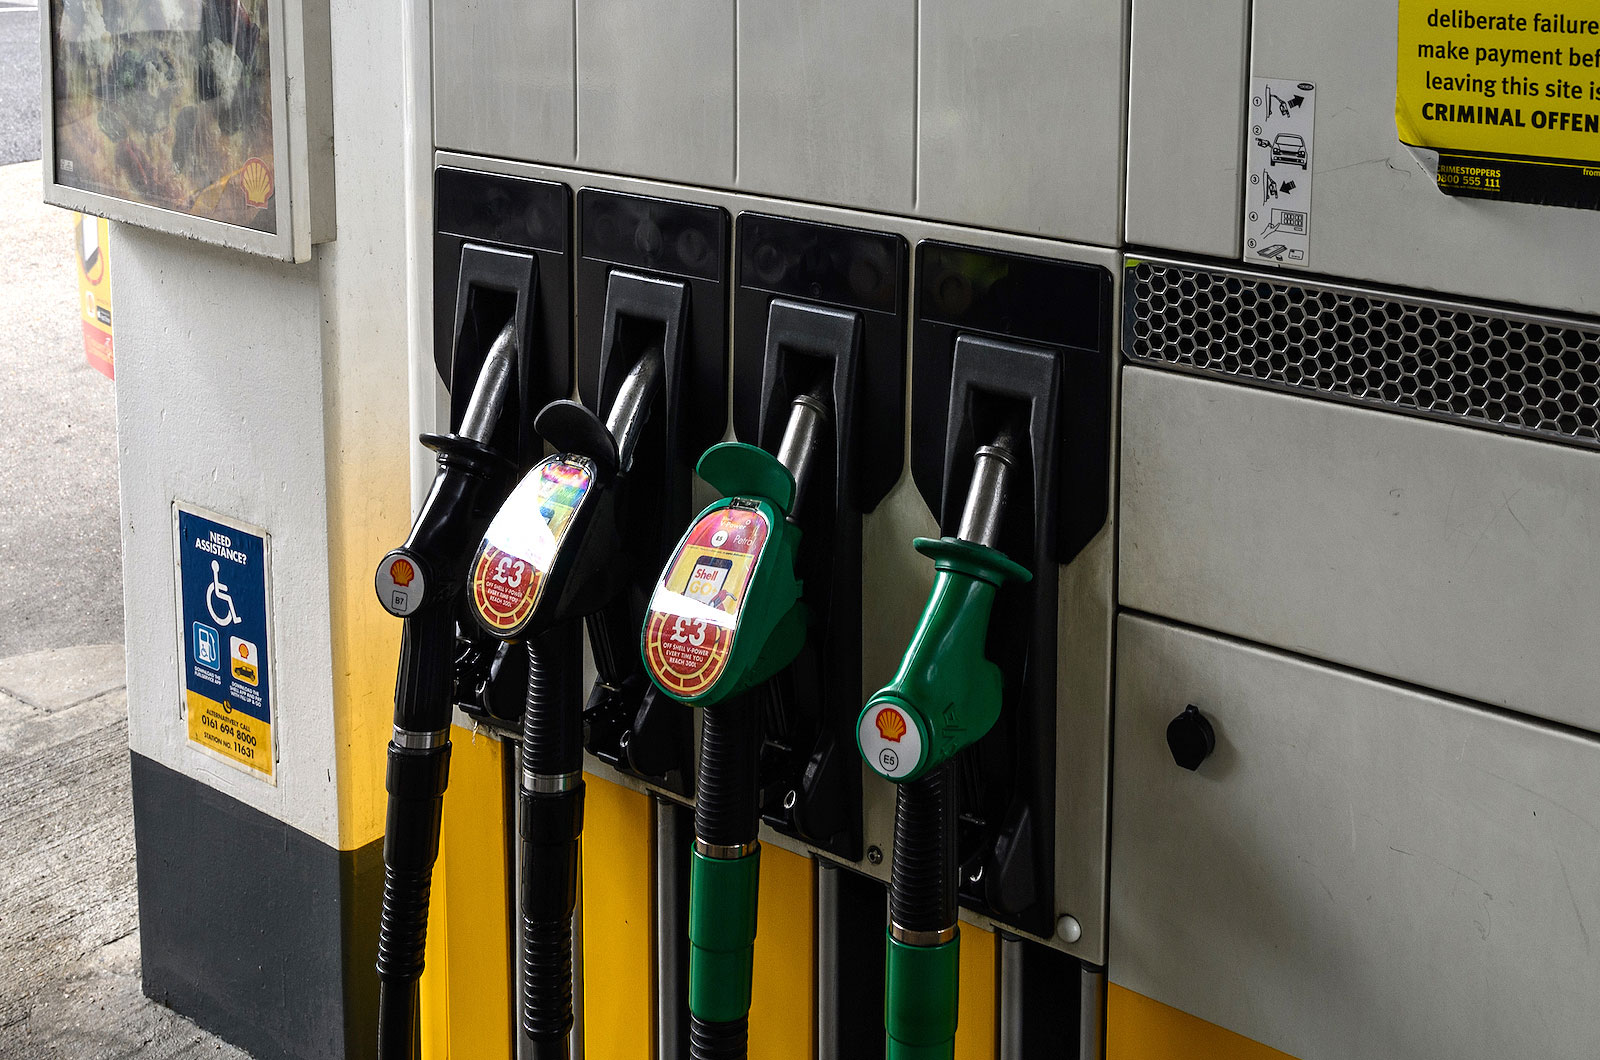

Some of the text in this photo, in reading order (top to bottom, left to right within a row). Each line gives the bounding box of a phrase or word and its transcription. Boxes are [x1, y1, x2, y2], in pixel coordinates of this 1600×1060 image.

[1427, 8, 1600, 35] deliberate failure
[1418, 40, 1470, 60] make
[1475, 47, 1563, 67] payment
[1426, 70, 1497, 98] leaving
[1501, 76, 1539, 97] this
[1545, 79, 1583, 99] site
[1421, 102, 1600, 133] CRIMINAL OFFEN
[1583, 167, 1600, 177] from
[1462, 176, 1481, 186] 555
[1485, 178, 1500, 188] 111
[209, 530, 232, 548] NEED
[195, 537, 247, 565] ASSISTANCE?
[492, 556, 526, 588] £3
[694, 568, 719, 582] Shell
[487, 588, 519, 603] EVERY TIME YOU
[494, 584, 505, 592] SHELL
[504, 587, 523, 598] V-POWER
[395, 596, 405, 605] B7
[490, 595, 503, 604] REACH
[670, 616, 708, 647] £3
[665, 649, 704, 663] EVERY TIME YOU
[673, 644, 686, 652] SHELL
[686, 647, 709, 657] V-POWER
[669, 657, 685, 665] REACH
[206, 708, 251, 733] ALTERNATIVELY CALL
[201, 714, 257, 747] 0161 694 8000
[204, 731, 222, 745] STATION
[234, 741, 254, 759] 11631
[883, 754, 895, 766] E5
